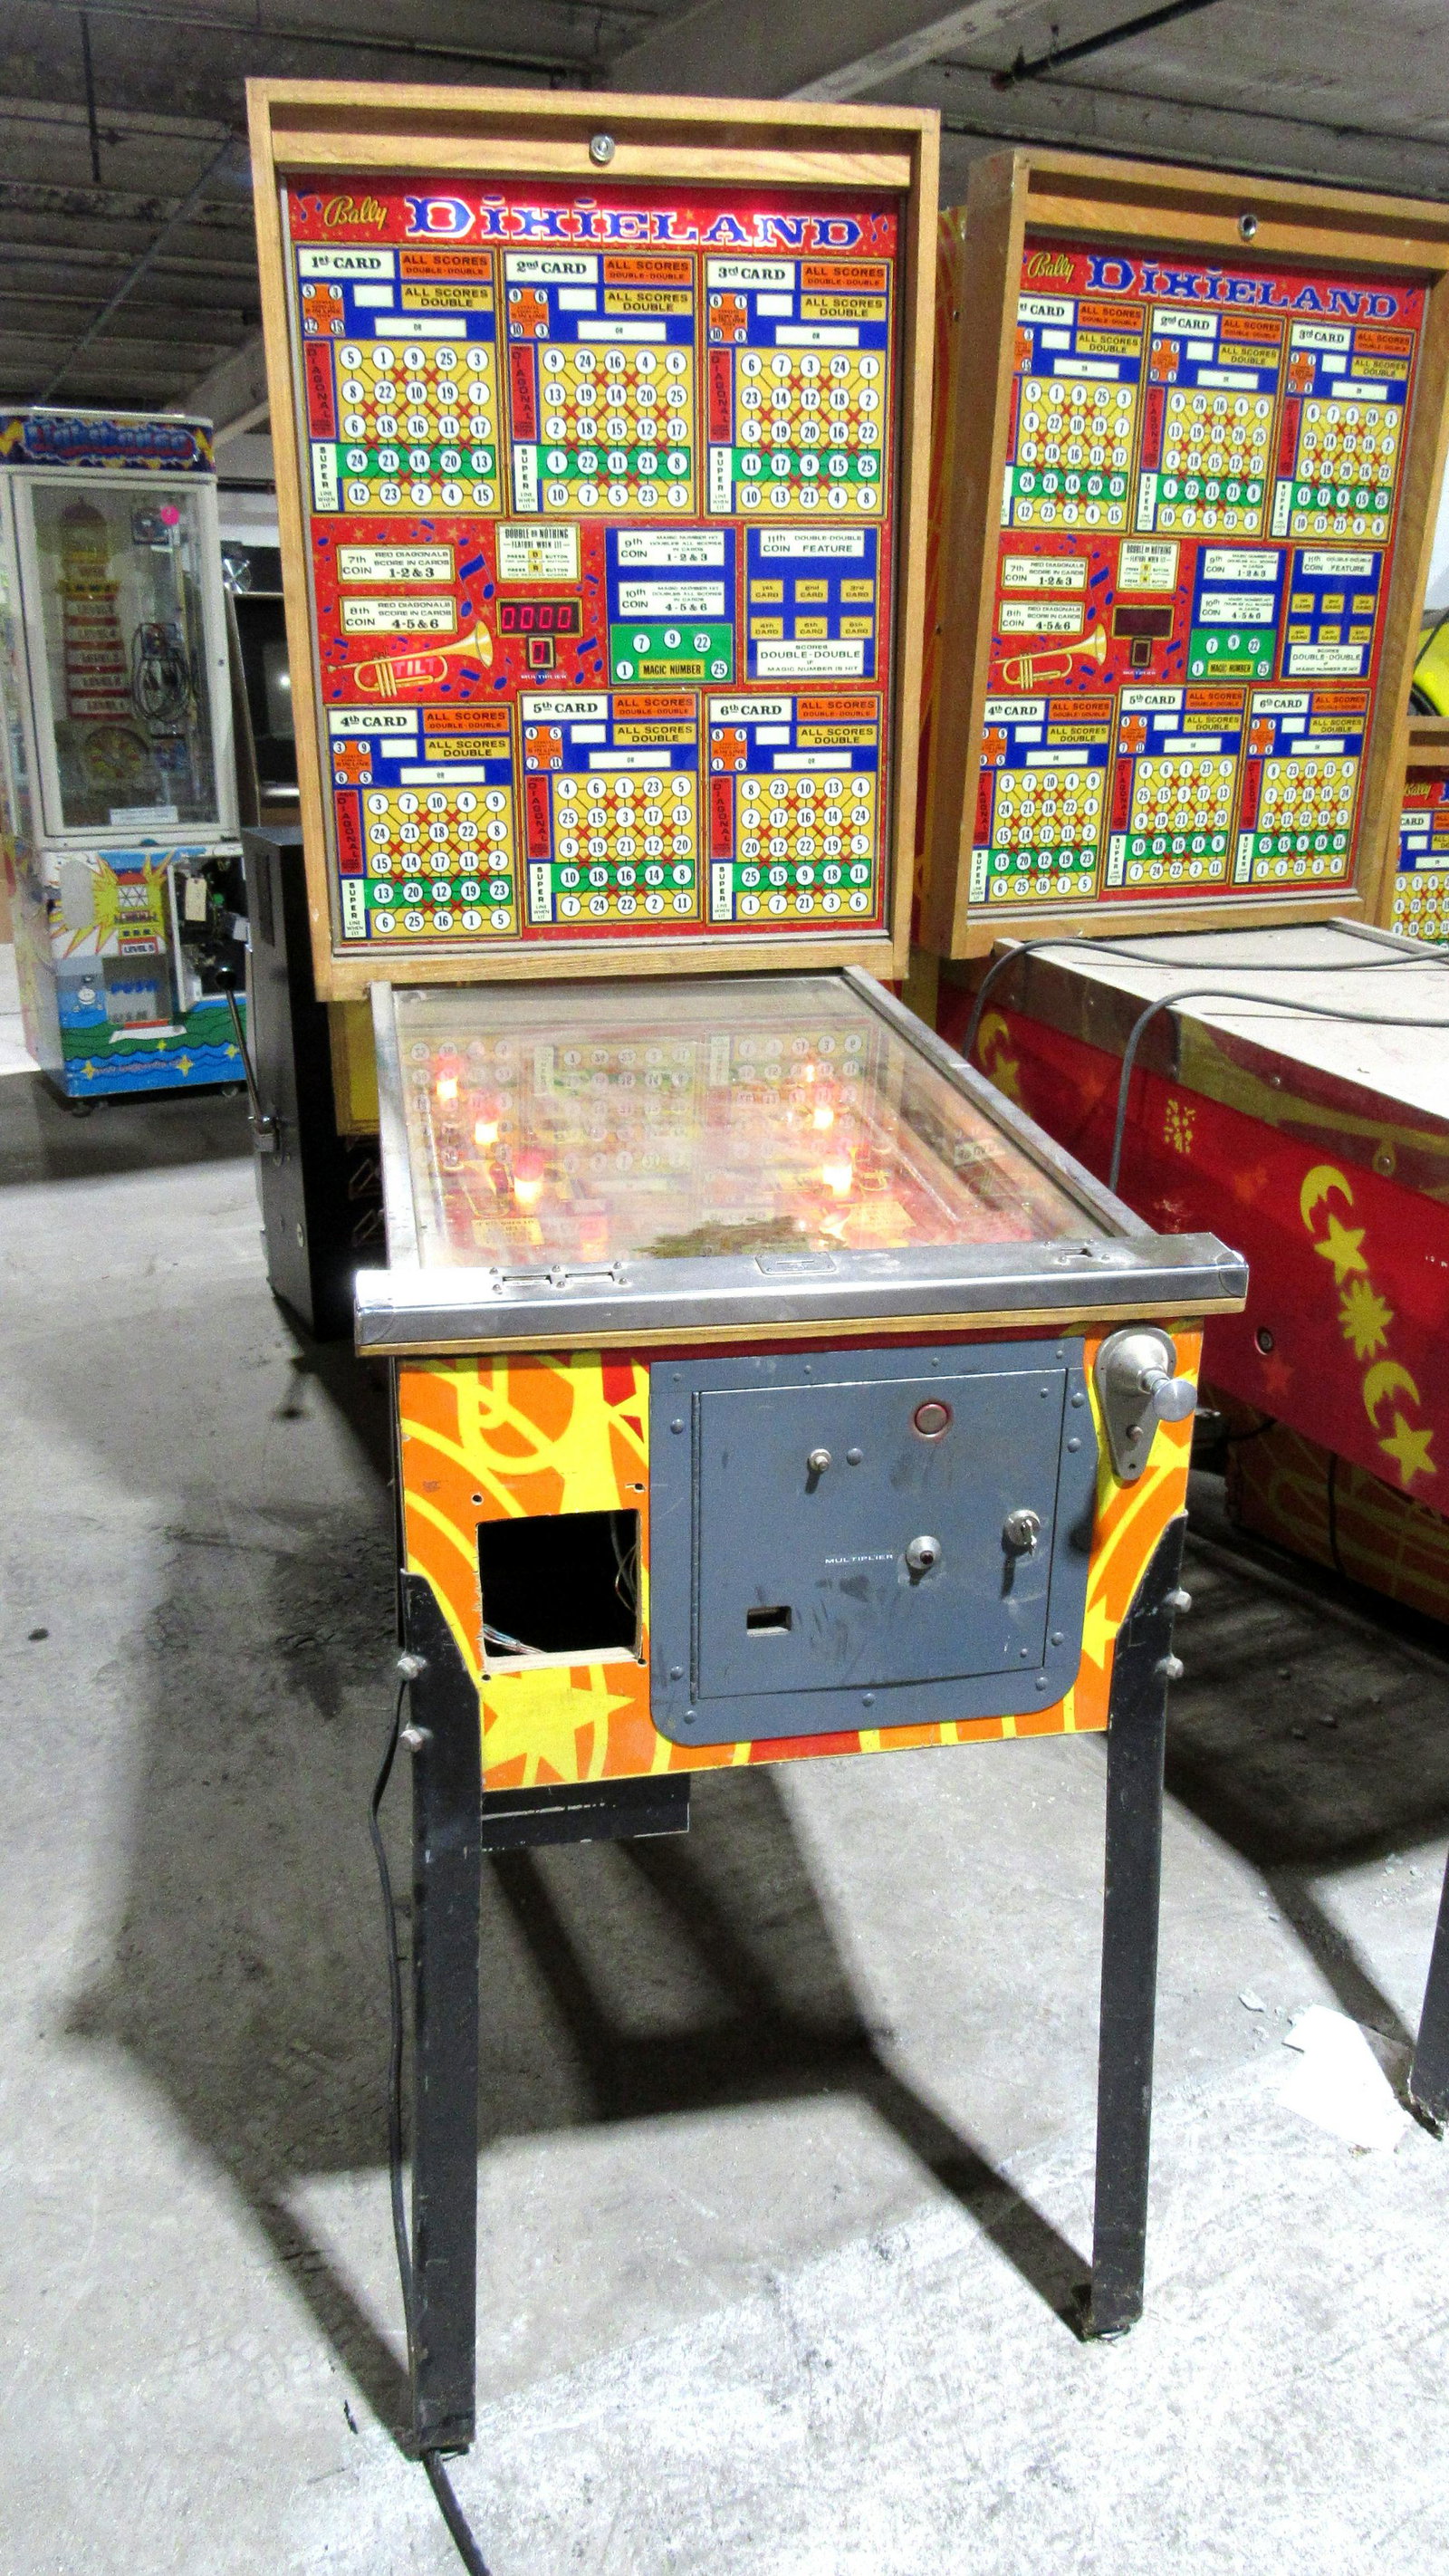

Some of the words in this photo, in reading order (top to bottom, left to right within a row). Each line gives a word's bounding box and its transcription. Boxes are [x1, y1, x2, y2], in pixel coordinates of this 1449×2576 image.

[323, 196, 388, 231] Bally
[312, 255, 330, 268] 1st
[333, 257, 381, 269] CARD
[403, 255, 427, 264] ALL
[433, 256, 488, 265] SCORES
[516, 261, 539, 273] 2nd
[541, 262, 587, 274] CARD
[608, 261, 629, 269] ALL
[637, 261, 688, 271] SCORES
[1028, 252, 1075, 284] Bally
[718, 265, 738, 278] 3rd
[741, 268, 786, 280] CARD
[805, 267, 828, 275] ALL
[834, 267, 884, 277] SCORES
[405, 288, 430, 297] ALL
[435, 288, 489, 297] SCORES
[609, 293, 632, 302] ALL
[639, 293, 688, 302] SCORES
[421, 298, 473, 307] DOUBLE
[623, 303, 674, 312] DOUBLE
[805, 298, 828, 306] ALL
[833, 299, 883, 308] SCORES
[820, 308, 868, 317] DOUBLE
[1030, 304, 1065, 317] CARD
[1178, 319, 1210, 331] CARD
[1314, 332, 1345, 343] CARD
[348, 351, 354, 363] 5
[381, 352, 386, 363] 1
[412, 353, 417, 364] 9
[441, 353, 452, 365] 25
[475, 354, 480, 365] 3
[350, 386, 356, 398] 8
[379, 386, 391, 398] 22
[412, 387, 422, 399] 10
[443, 387, 453, 399] 19
[477, 388, 481, 399] 7
[352, 420, 358, 432] 6
[382, 420, 393, 432] 18
[413, 420, 424, 432] 16
[445, 422, 454, 433] 11
[475, 422, 485, 433] 17
[352, 455, 362, 466] 24
[383, 455, 394, 466] 21
[414, 456, 425, 466] 14
[446, 456, 456, 467] 20
[476, 456, 487, 467] 13
[320, 447, 330, 488] SUPER
[354, 489, 365, 501] 12
[386, 488, 397, 500] 23
[418, 489, 423, 500] 2
[449, 490, 454, 500] 4
[478, 490, 488, 501] 15
[505, 528, 529, 539] DOUBLE
[539, 528, 569, 539] NOTHING
[763, 544, 791, 553] COIN
[802, 544, 853, 553] FEATURE
[621, 550, 648, 558] COIN
[413, 569, 423, 578] &
[426, 568, 435, 578] 3
[622, 601, 648, 609] COIN
[350, 607, 369, 615] 8th
[417, 620, 427, 629] &
[430, 619, 439, 629] 6
[639, 638, 644, 649] 7
[670, 634, 676, 646] 9
[696, 637, 707, 649] 22
[394, 658, 437, 677] TILT
[623, 665, 628, 676] 1
[643, 665, 667, 675] MAGIC
[670, 664, 701, 675] NUMBER
[714, 664, 724, 676] 25
[618, 698, 640, 707] ALL
[645, 698, 693, 706] SCORES
[801, 701, 820, 709] ALL
[826, 700, 875, 709] SCORES
[1145, 696, 1176, 705] CARD
[1273, 699, 1302, 707] CARD
[533, 701, 552, 714] 5th
[555, 702, 599, 713] CARD
[721, 704, 739, 716] 6th
[741, 705, 782, 716] CARD
[1004, 706, 1038, 716] CARD
[341, 715, 360, 727] 4th
[362, 716, 408, 727] CARD
[427, 712, 446, 721] ALL
[456, 712, 505, 721] SCORES
[618, 726, 640, 735] ALL
[645, 726, 693, 734] SCORES
[801, 728, 821, 736] ALL
[826, 727, 874, 735] SCORES
[428, 740, 449, 749] ALL
[456, 739, 506, 748] SCORES
[631, 735, 679, 743] DOUBLE
[815, 735, 859, 744] DOUBLE
[444, 748, 492, 757] DOUBLE
[349, 882, 357, 918] SUPER
[825, 1554, 893, 1564] MULTIPLIER
